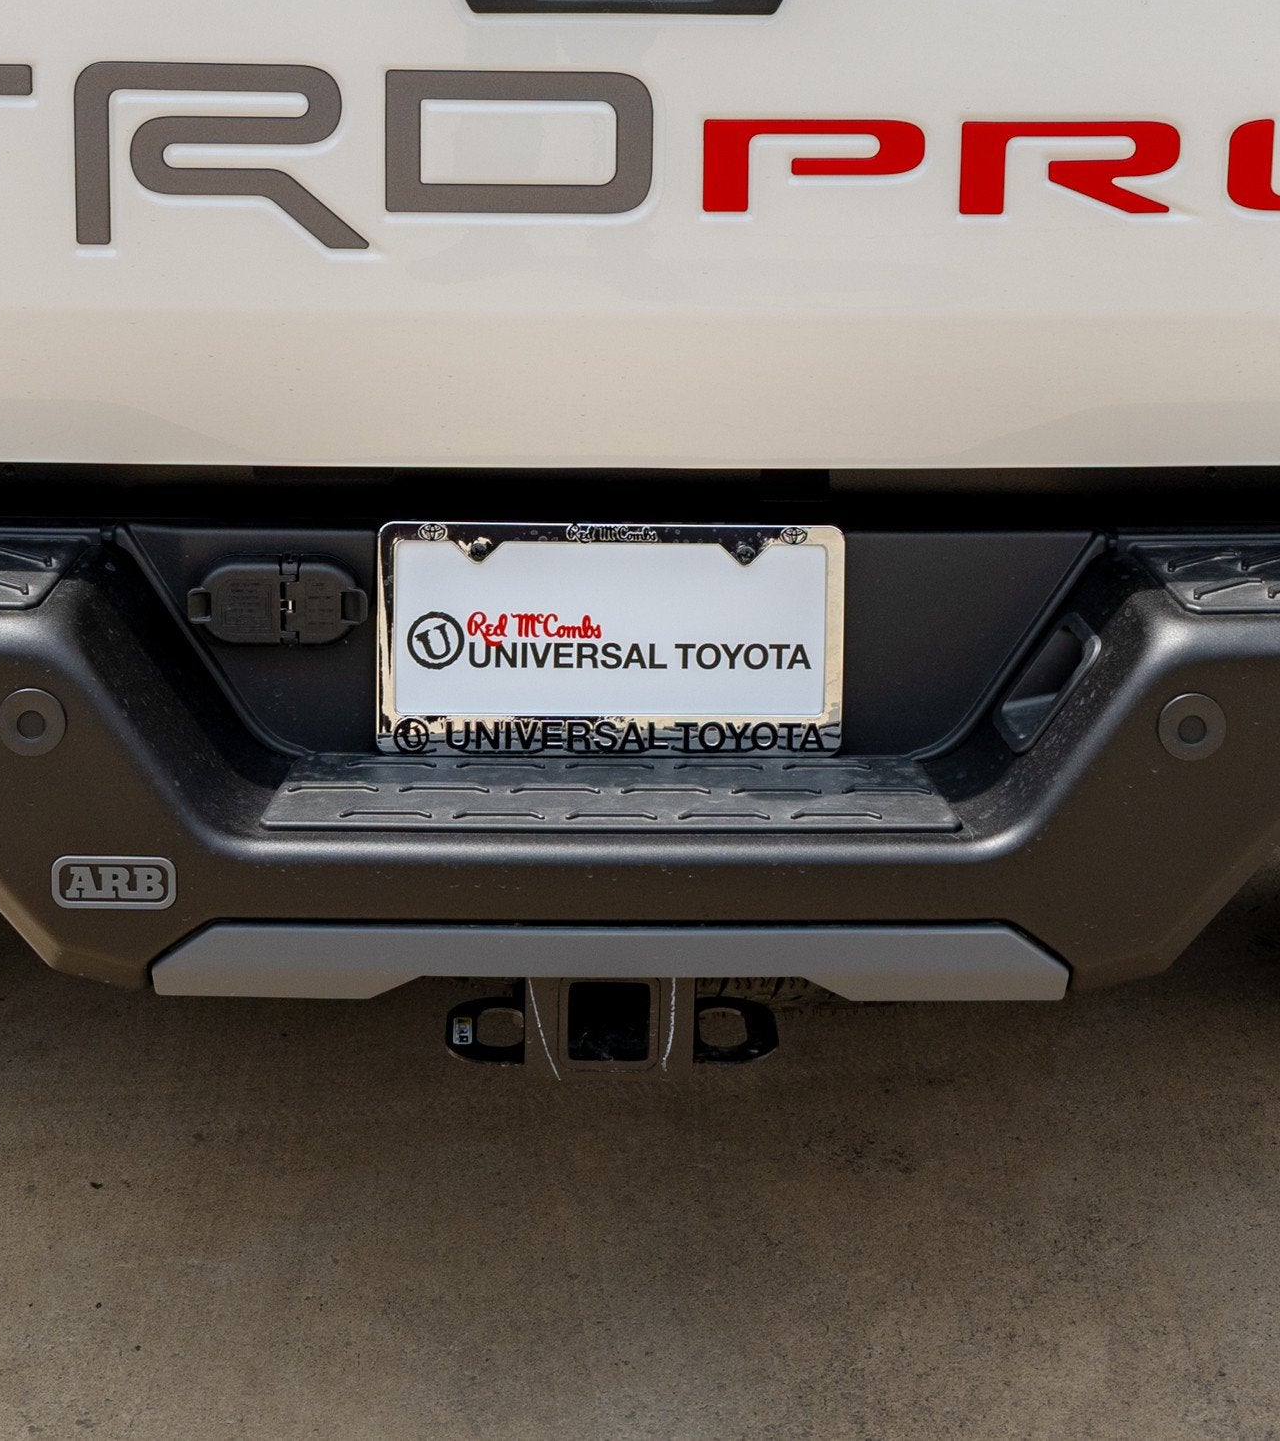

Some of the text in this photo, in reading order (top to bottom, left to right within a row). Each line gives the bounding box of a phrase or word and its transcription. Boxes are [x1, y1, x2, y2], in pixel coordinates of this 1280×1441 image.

[466, 611, 602, 647] Red McCombs
[468, 641, 812, 670] UNIVERSAL TOYOTA
[444, 719, 670, 751] UNIVERSAL
[674, 721, 825, 751] TOYOTA
[65, 866, 165, 899] ARB
